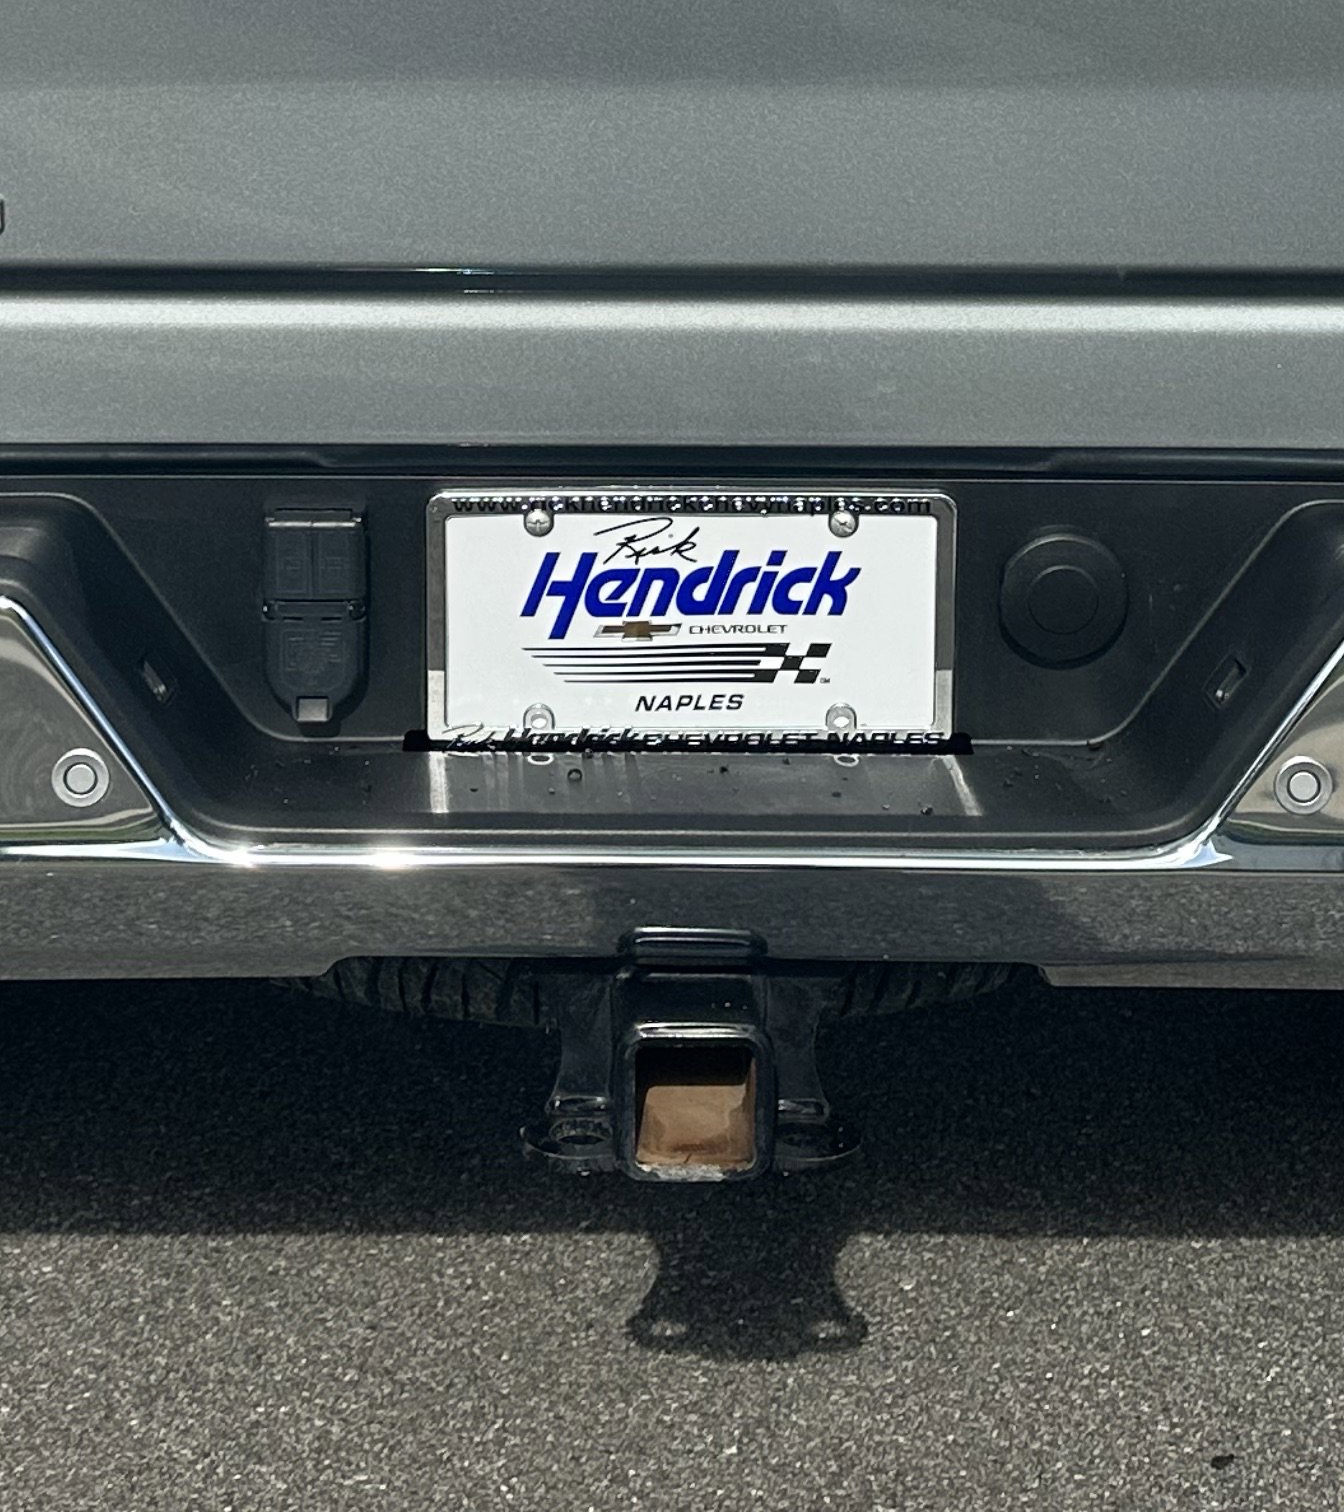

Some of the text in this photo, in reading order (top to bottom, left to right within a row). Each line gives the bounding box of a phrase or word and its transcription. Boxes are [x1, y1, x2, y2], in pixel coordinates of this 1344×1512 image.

[520, 550, 861, 639] Hendrick
[689, 624, 788, 635] CHEVROLET
[635, 694, 744, 711] NAPLES
